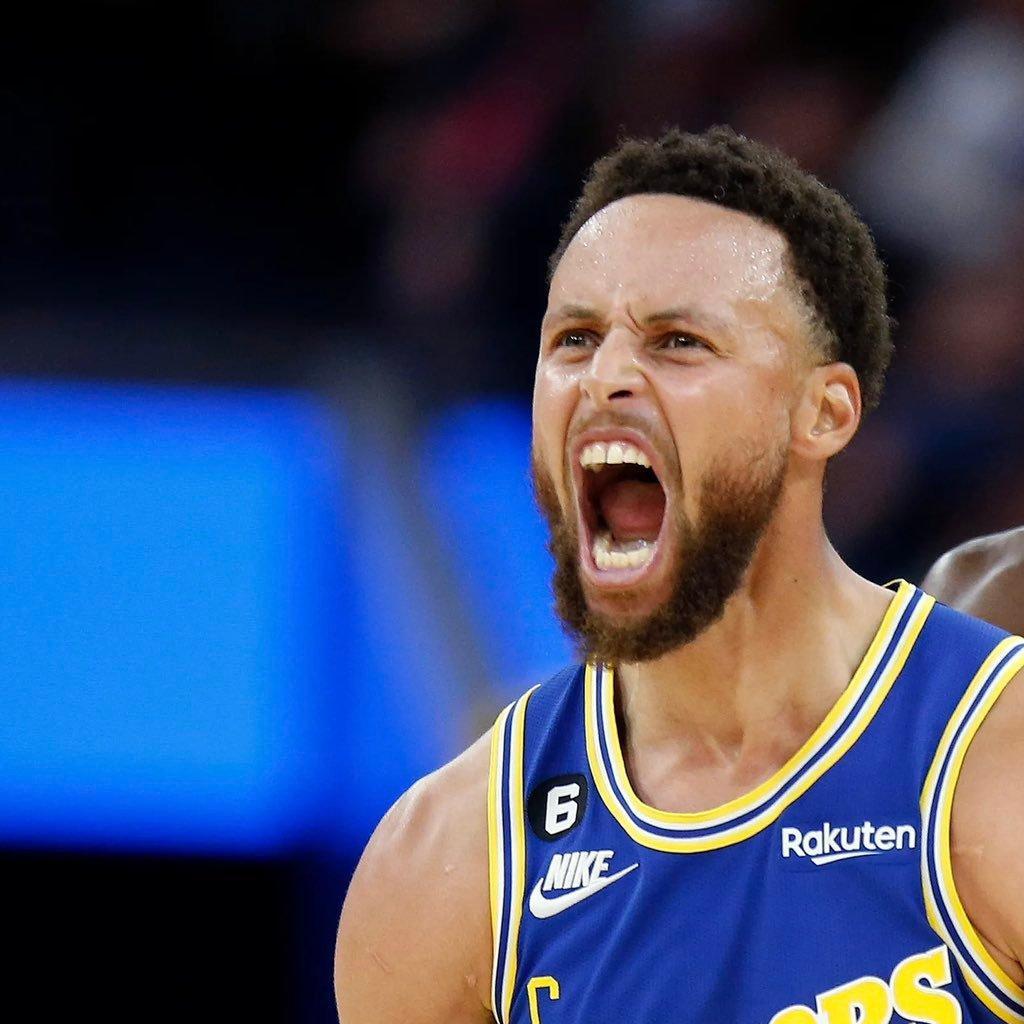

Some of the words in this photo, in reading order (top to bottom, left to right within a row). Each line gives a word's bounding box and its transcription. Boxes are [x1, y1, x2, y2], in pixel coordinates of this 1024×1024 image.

[544, 782, 581, 836] 6
[781, 821, 917, 858] Rakuten
[542, 849, 616, 892] NIKE
